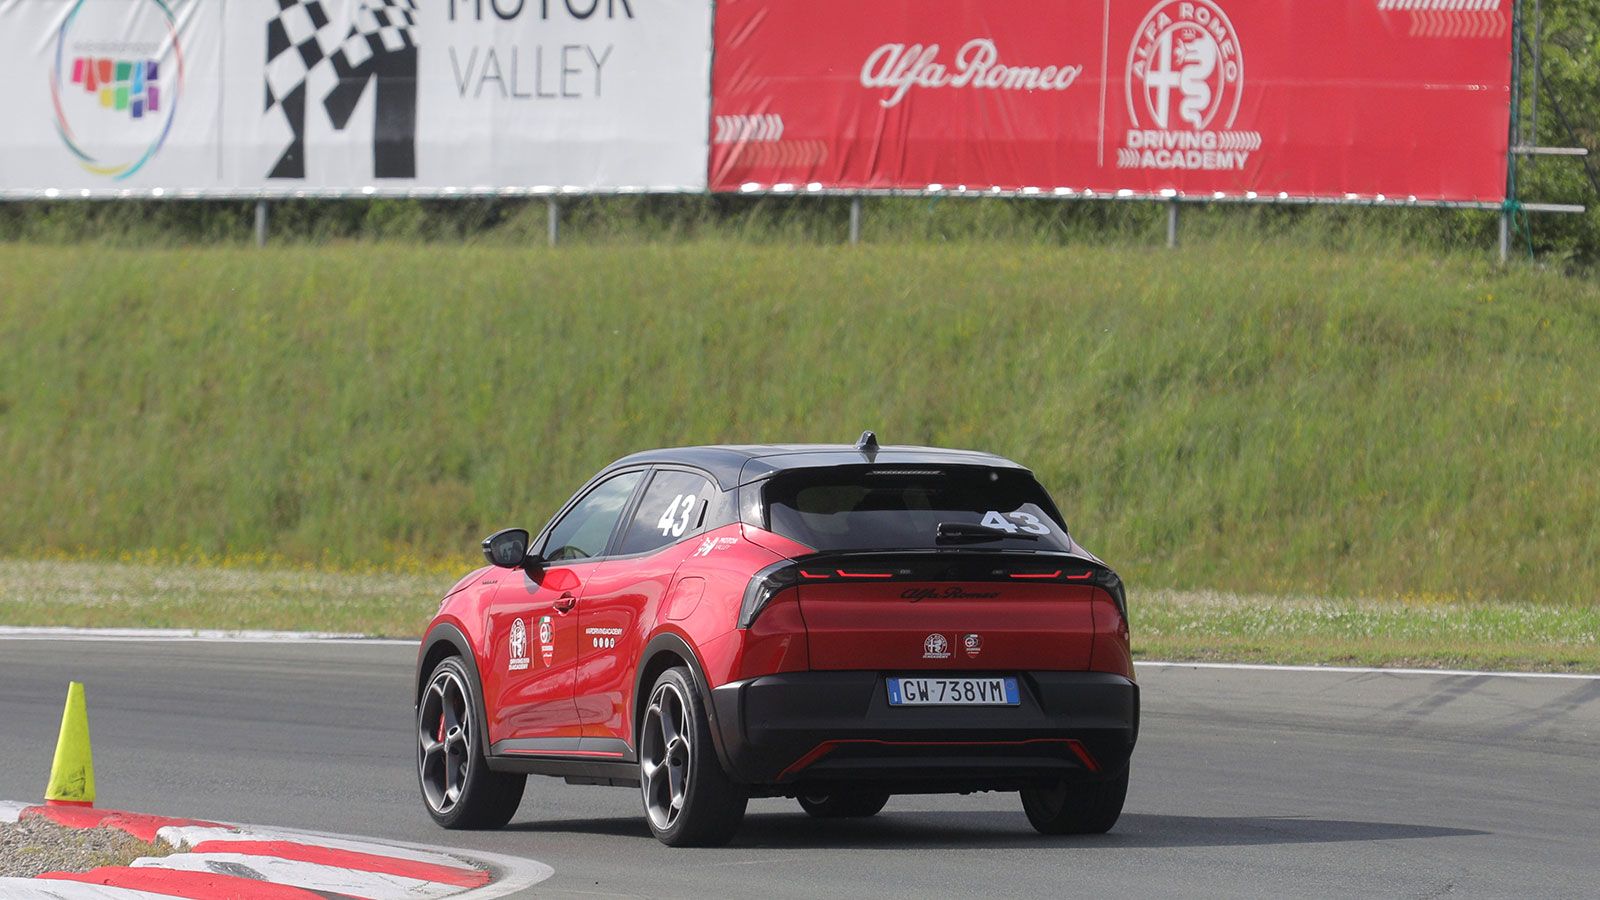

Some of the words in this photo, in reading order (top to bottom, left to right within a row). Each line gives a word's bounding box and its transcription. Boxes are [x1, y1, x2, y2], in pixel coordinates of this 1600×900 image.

[1134, 12, 1172, 80] ALFA
[1179, 2, 1238, 82] ROMEO
[449, 45, 614, 99] VALLEY
[860, 43, 951, 108] Alfa
[951, 38, 1083, 90] Romeo
[1127, 129, 1218, 149] DRIVING
[1141, 150, 1249, 170] ACADEMY
[657, 494, 696, 537] 43
[980, 510, 1051, 535] 43
[903, 680, 930, 702] GW
